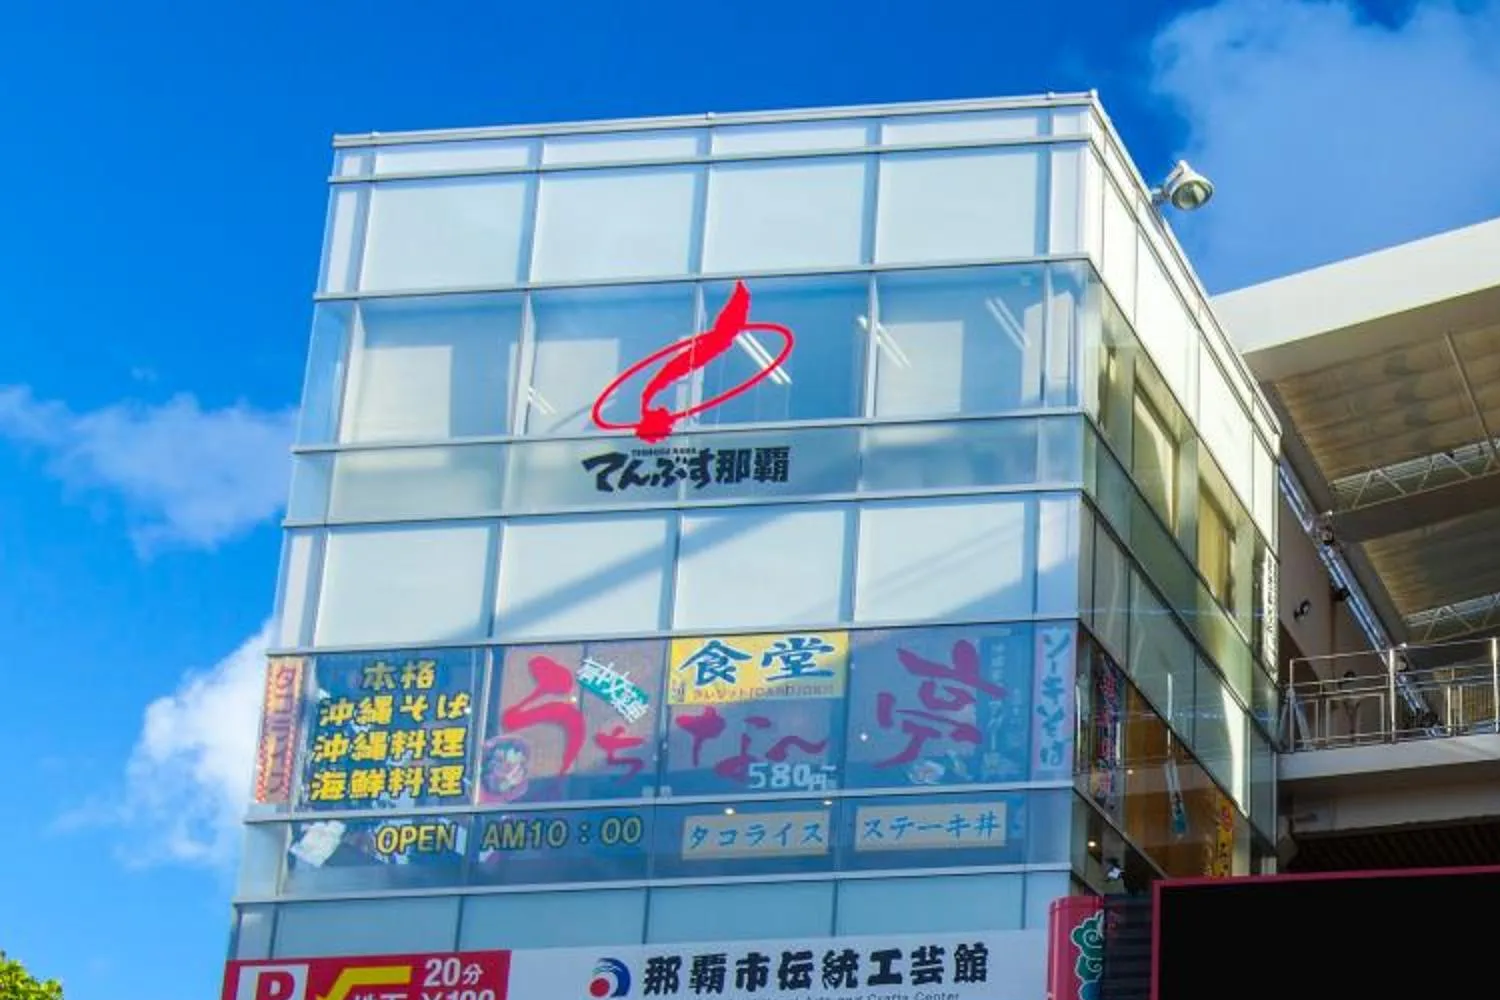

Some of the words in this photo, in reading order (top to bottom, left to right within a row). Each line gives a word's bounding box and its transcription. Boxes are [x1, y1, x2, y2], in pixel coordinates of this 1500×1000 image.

[581, 446, 791, 493] てんぶす那覇
[363, 659, 437, 692] 本格
[679, 638, 836, 686] 食堂
[319, 692, 471, 727] 沖縄そば
[312, 725, 470, 764] 沖縄料理
[309, 763, 466, 801] 海鮮料理
[376, 823, 458, 856] OPEN
[688, 818, 824, 850] タコライス
[863, 812, 1000, 841] ステーキ丼
[424, 957, 485, 987] 20分
[643, 942, 990, 997] 那覇市伝統工芸館
